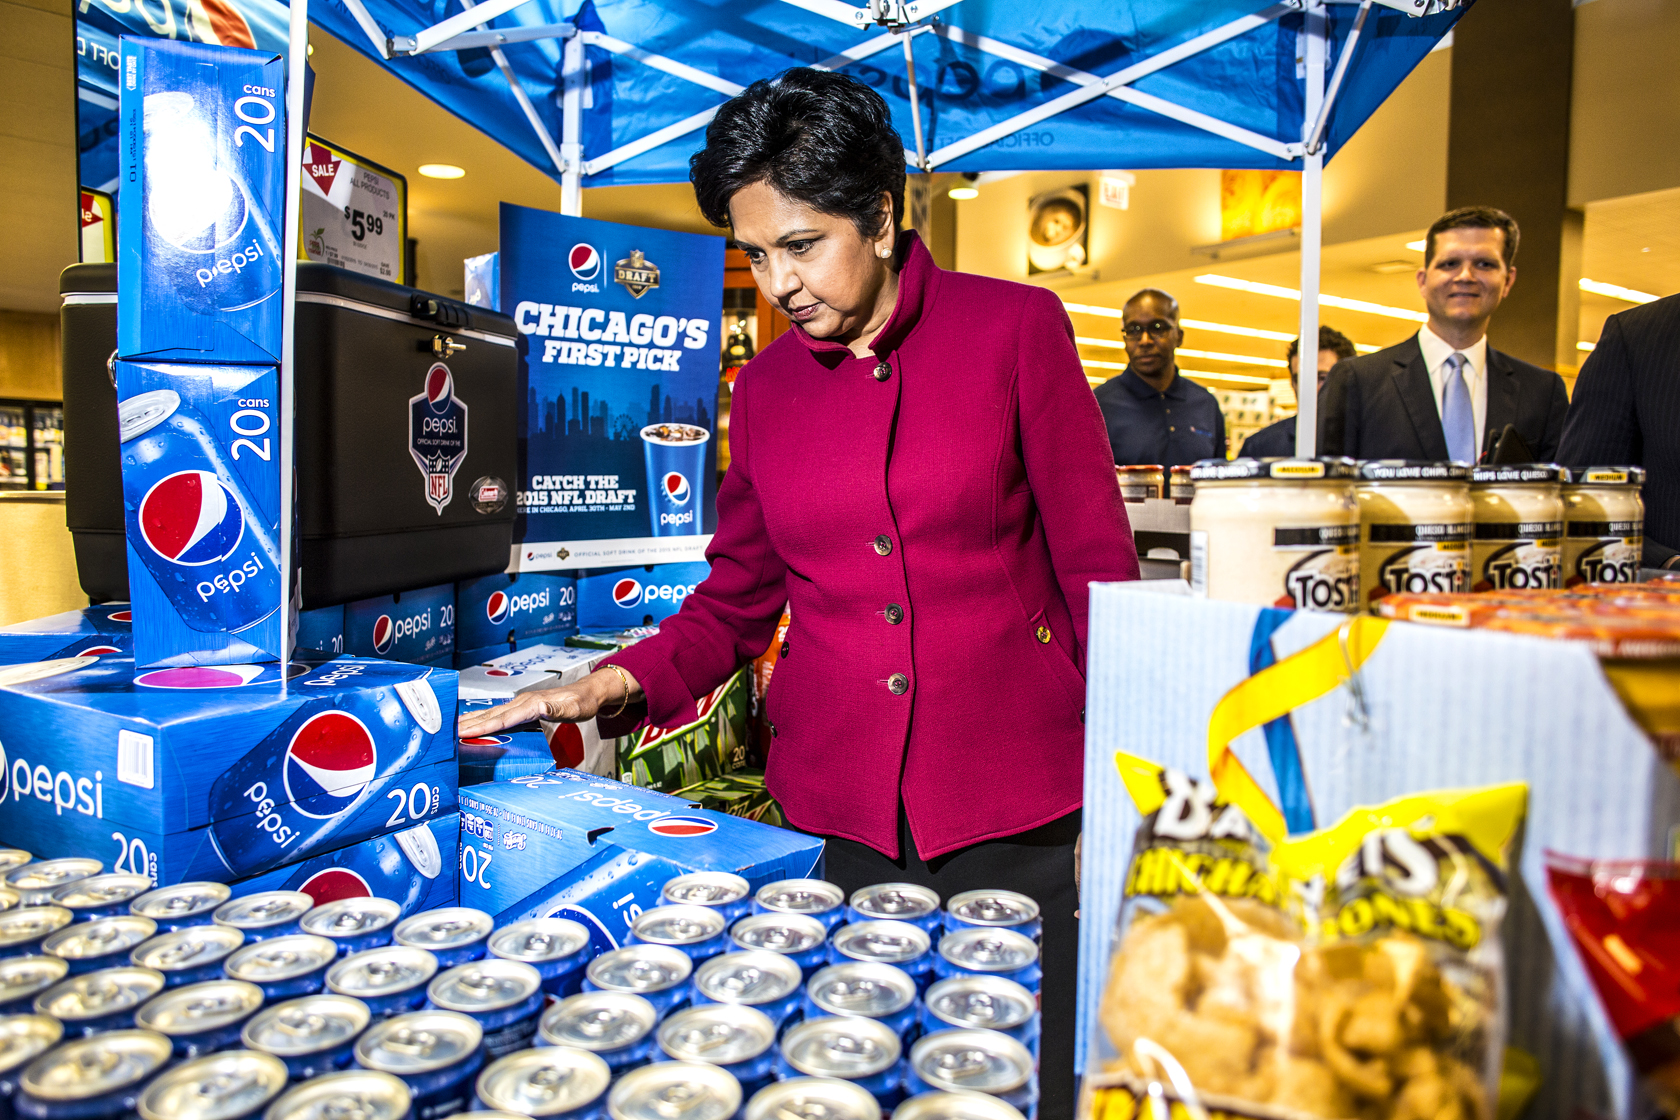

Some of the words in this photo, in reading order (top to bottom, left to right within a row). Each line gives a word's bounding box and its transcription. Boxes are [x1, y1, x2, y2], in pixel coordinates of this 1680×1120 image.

[243, 84, 276, 98] cans
[234, 96, 276, 152] 20
[312, 164, 334, 177] SALE
[364, 172, 379, 186] PEPSI
[350, 178, 360, 188] ALL
[361, 180, 390, 200] PRODUCTS
[195, 240, 264, 288] pepsi
[618, 270, 656, 282] DRAFT
[572, 282, 598, 294] pepsi
[514, 301, 710, 349] CHICAGO'S
[542, 340, 621, 367] FIRST
[621, 347, 682, 371] PICK
[238, 398, 270, 408] cans
[230, 409, 271, 461] 20
[423, 416, 456, 436] pepsi
[532, 475, 585, 490] CATCH
[587, 475, 618, 489] THE
[1396, 467, 1420, 478] LOVE
[1497, 471, 1520, 480] LOVE
[1521, 470, 1546, 480] QUESO
[430, 475, 447, 498] NFL
[517, 491, 548, 506] 2015
[551, 490, 583, 505] NFL
[585, 490, 636, 504] DRAFT
[660, 510, 693, 527] pepsi
[1609, 524, 1630, 532] QUESO
[536, 552, 552, 560] pepsi
[196, 552, 264, 602] pepsi
[510, 588, 549, 617] pepsi
[559, 586, 574, 606] 20
[645, 580, 702, 604] peps
[395, 608, 431, 644] pepsi
[440, 604, 453, 628] 20
[332, 635, 343, 653] 20
[304, 665, 367, 686] pepsi
[733, 745, 745, 761] 20
[12, 758, 103, 818] pepsi
[509, 775, 564, 789] 20
[385, 782, 431, 827] 20
[431, 786, 439, 815] cans
[469, 799, 479, 810] CANS
[558, 791, 671, 821] pepsi
[244, 782, 300, 848] pepsi
[527, 818, 537, 831] CANS
[112, 832, 149, 876] 20
[149, 852, 158, 887] cans
[462, 845, 492, 889] 20
